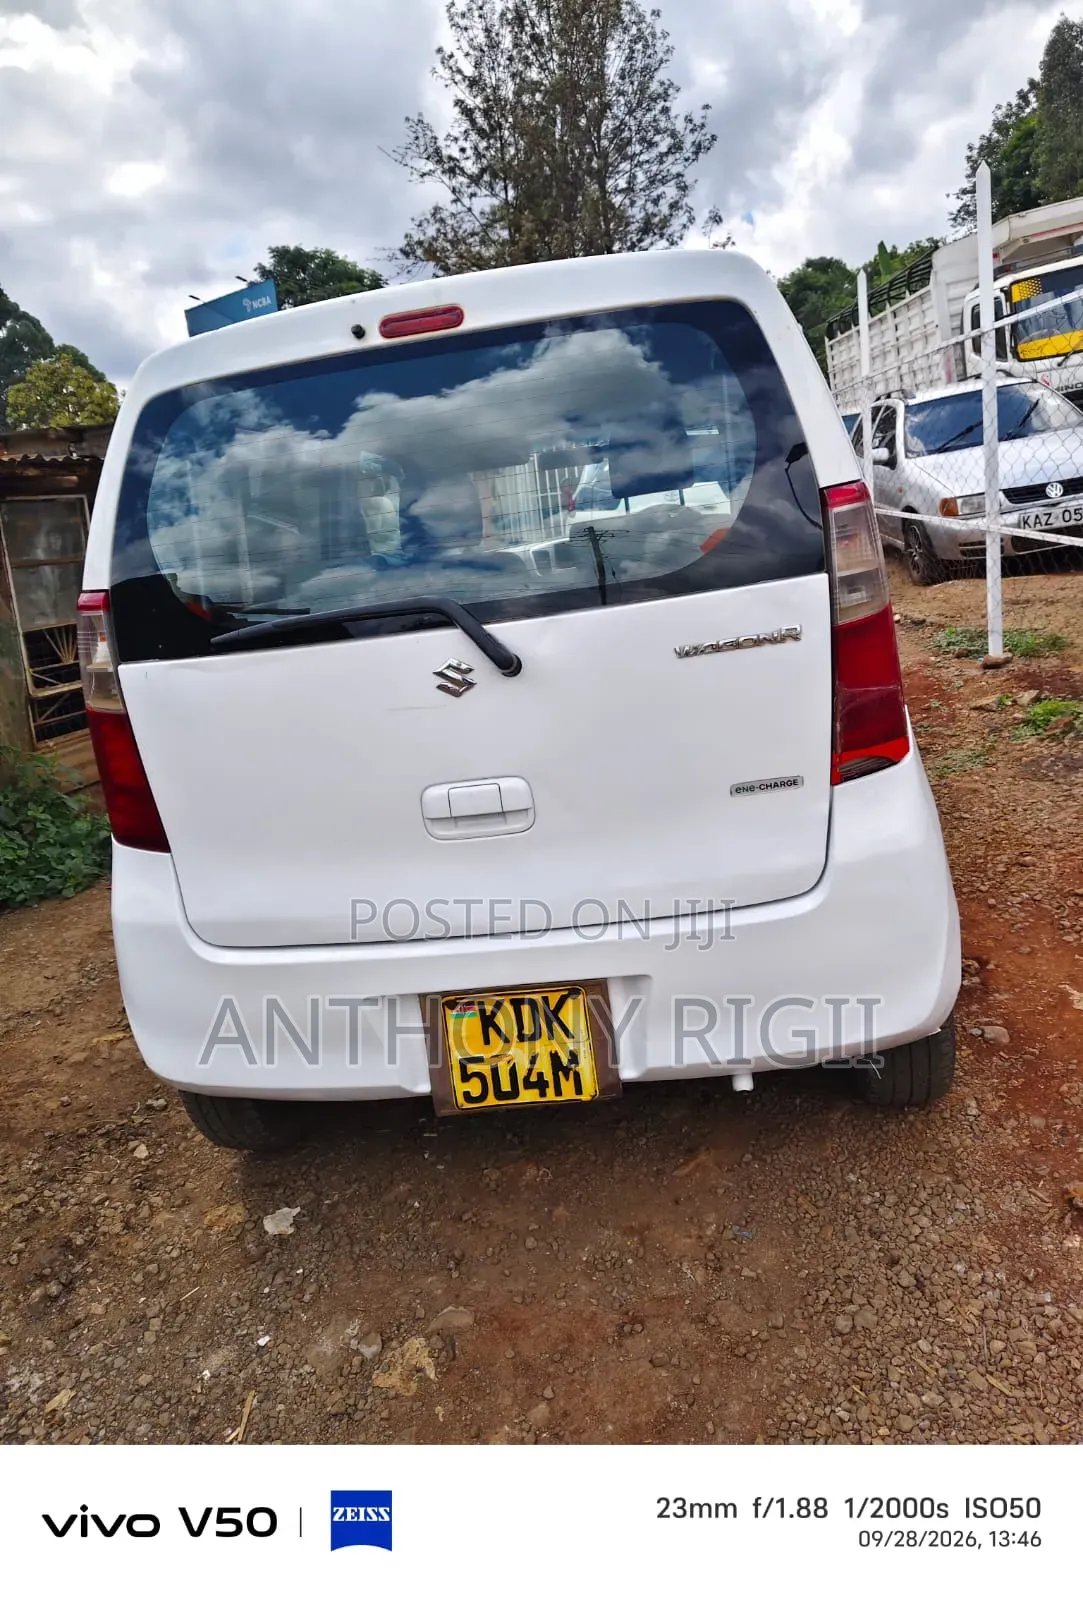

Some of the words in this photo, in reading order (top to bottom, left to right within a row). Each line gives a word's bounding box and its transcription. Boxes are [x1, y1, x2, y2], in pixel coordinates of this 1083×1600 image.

[1022, 512, 1053, 529] KAZ
[477, 991, 576, 1046] KDK
[459, 1050, 583, 1103] 504M
